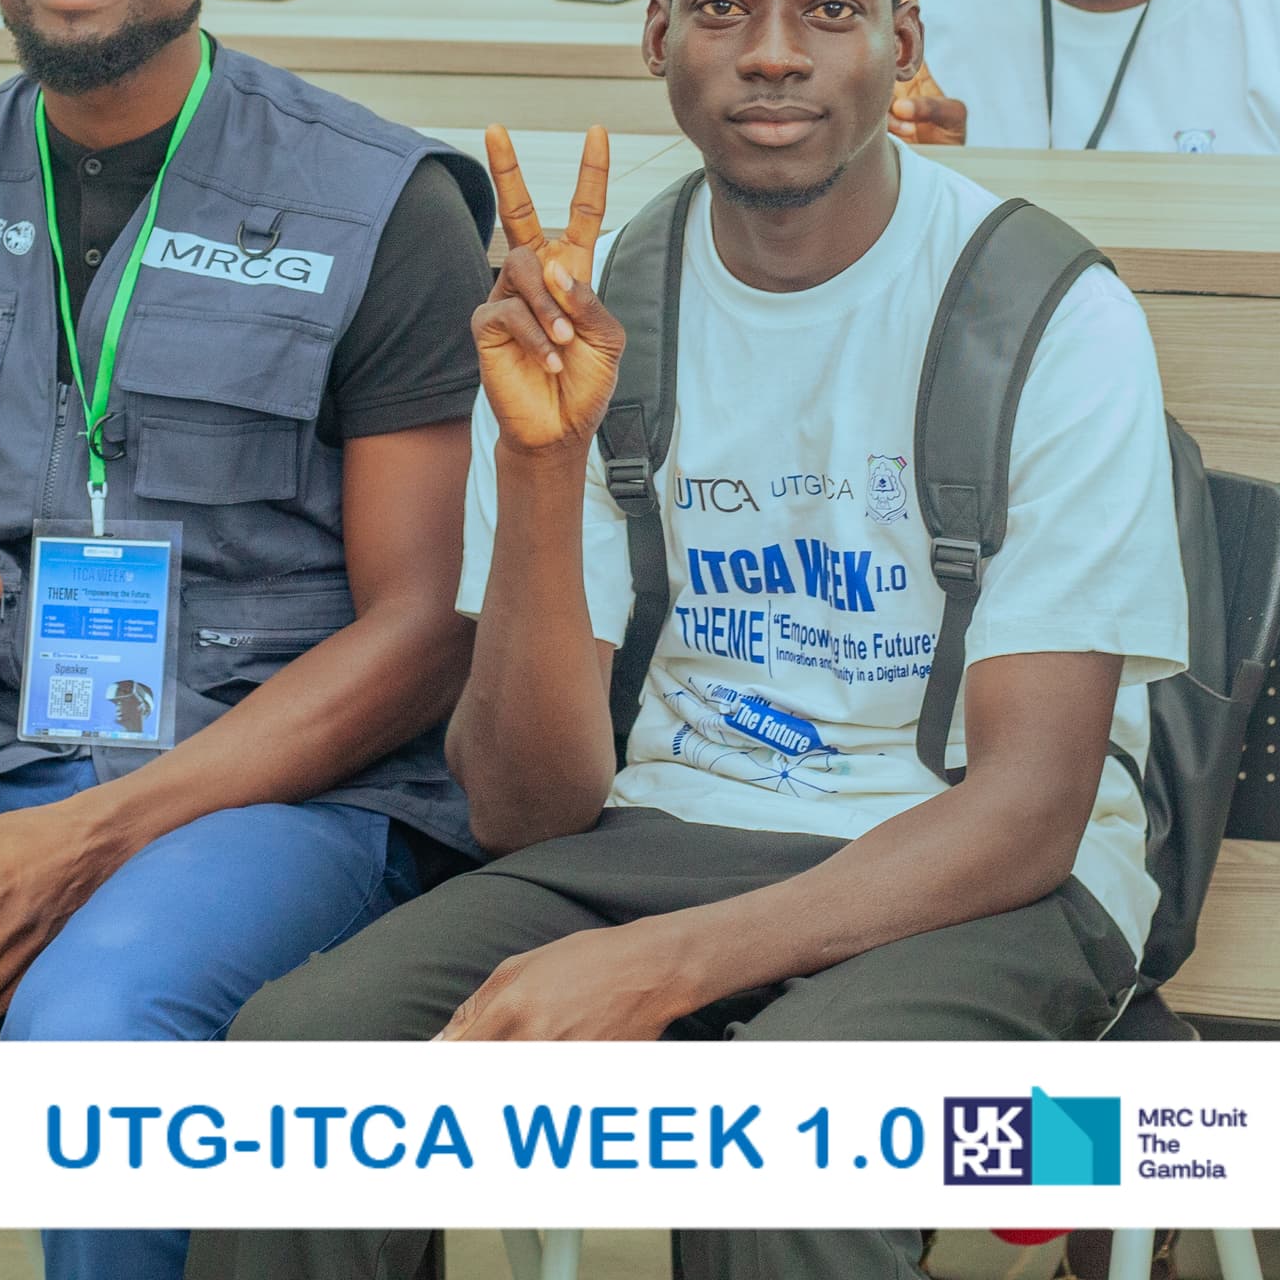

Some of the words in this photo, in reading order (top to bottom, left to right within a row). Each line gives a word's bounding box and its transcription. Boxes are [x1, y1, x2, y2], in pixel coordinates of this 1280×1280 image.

[160, 239, 312, 283] MRCG
[688, 543, 796, 595] ITCA
[675, 606, 765, 664] THEME
[844, 633, 868, 660] the
[857, 665, 866, 681] in
[868, 671, 874, 682] a
[877, 666, 910, 683] Digital
[732, 702, 763, 731] The
[758, 714, 812, 754] Future
